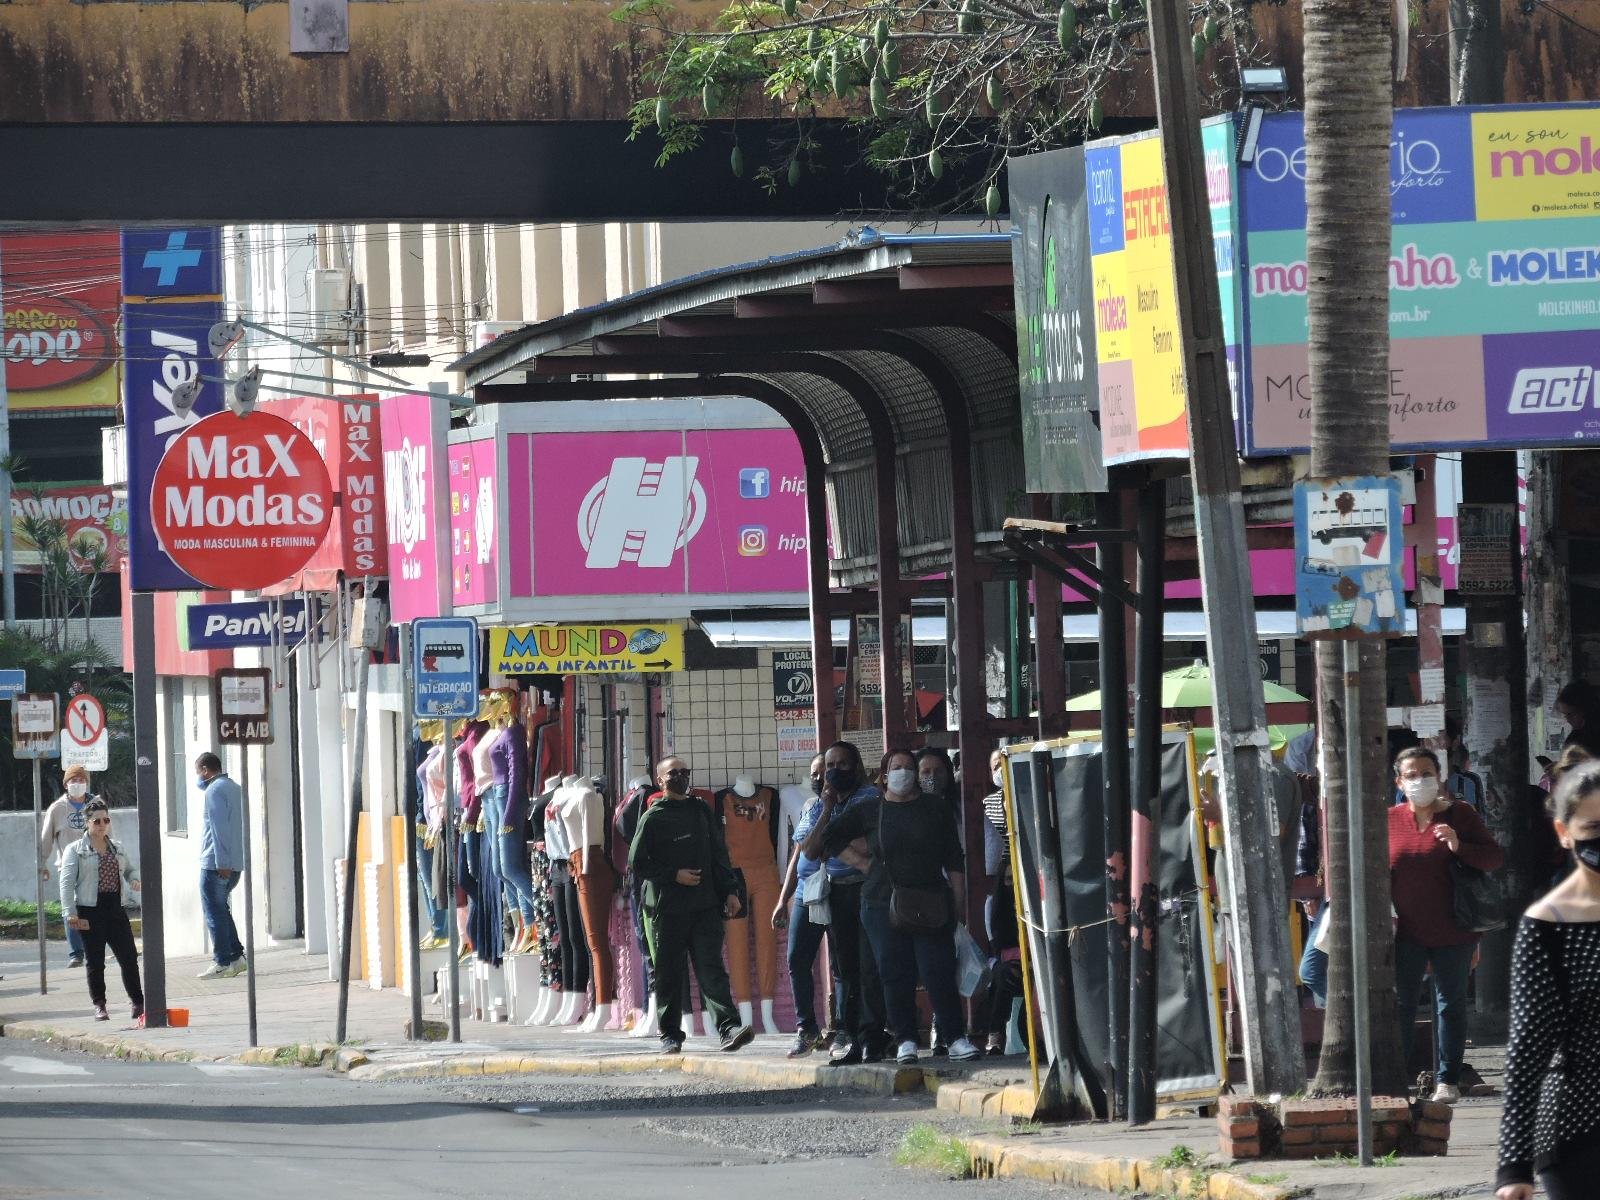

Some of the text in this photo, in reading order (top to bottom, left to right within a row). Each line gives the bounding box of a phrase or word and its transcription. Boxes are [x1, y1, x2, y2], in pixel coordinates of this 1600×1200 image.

[1568, 190, 1600, 199] moleca.co
[1466, 257, 1483, 279] &
[1490, 250, 1600, 283] MOLEK
[1538, 299, 1600, 316] MOLEKINHO.
[164, 484, 325, 528] Modas
[346, 475, 376, 570] Modas
[174, 536, 316, 550] MODA MASCULINA & FEMININA
[783, 652, 811, 661] LOCAL
[499, 658, 636, 672] MODA INFANTIL
